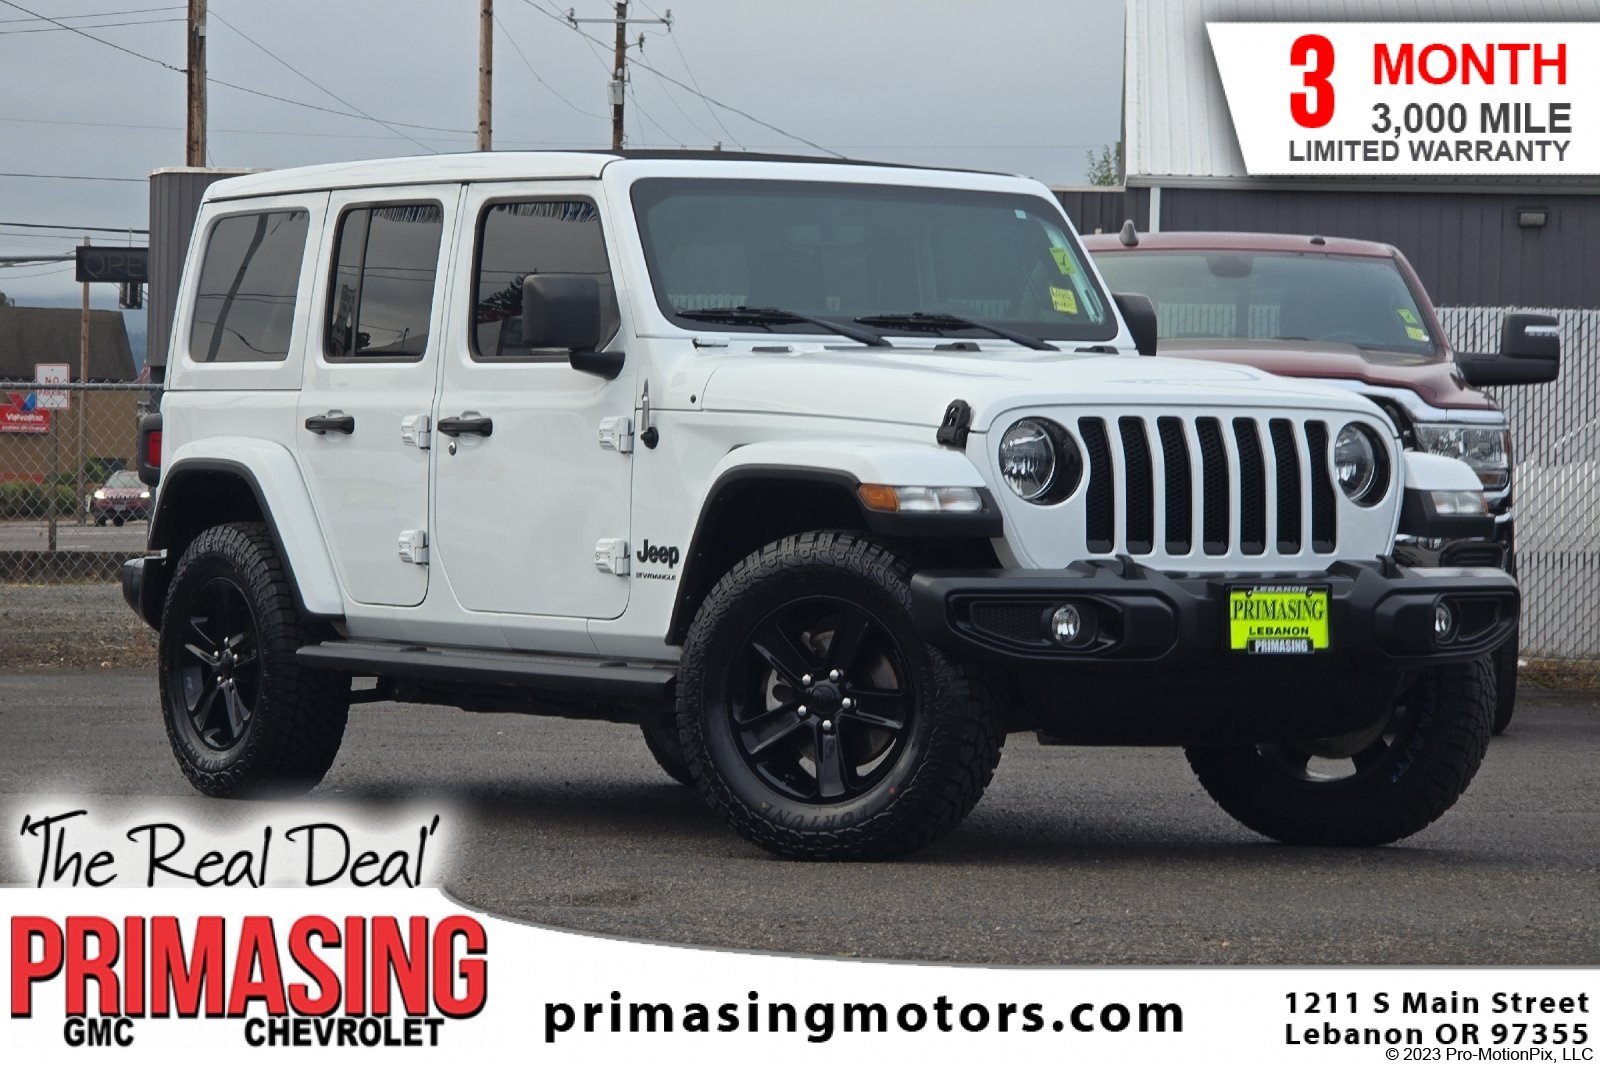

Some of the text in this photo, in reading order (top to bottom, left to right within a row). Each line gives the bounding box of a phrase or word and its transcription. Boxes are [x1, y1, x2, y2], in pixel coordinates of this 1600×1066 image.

[636, 538, 680, 569] Jeep
[1252, 585, 1308, 594] LEBANON
[1233, 599, 1324, 621] PRIMASING
[1249, 626, 1309, 635] LEBANON
[1255, 640, 1308, 653] PRIMASING
